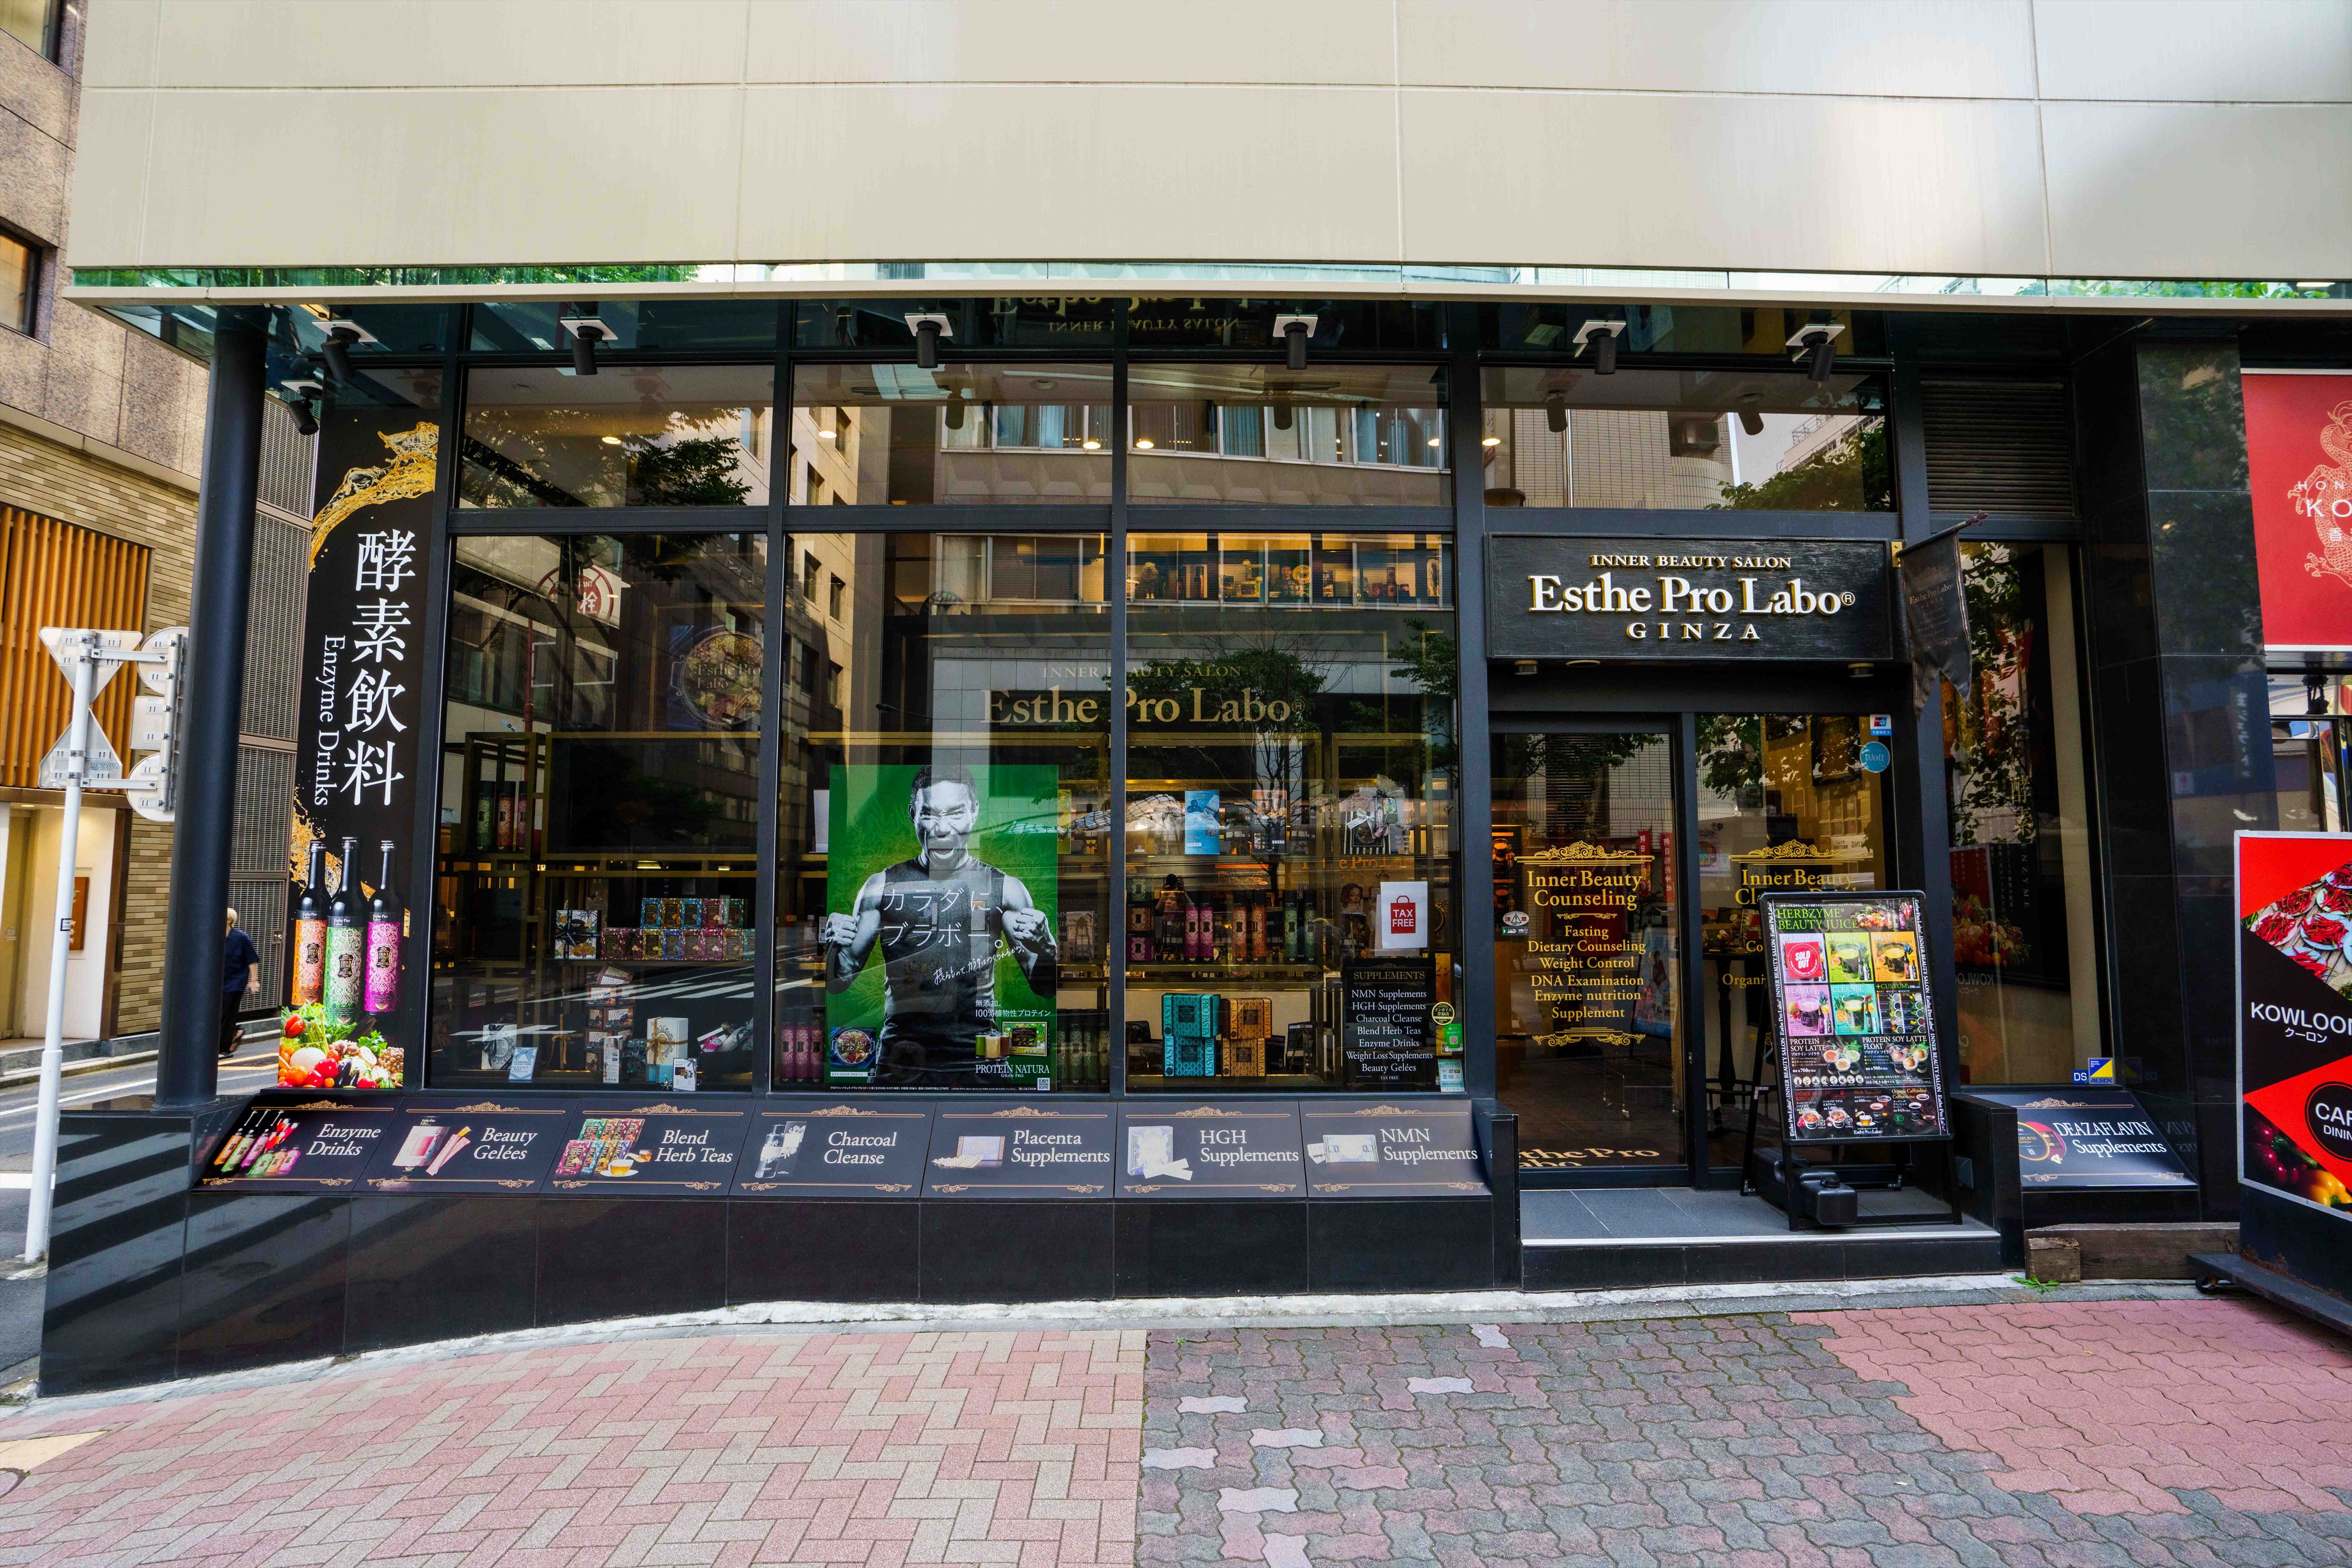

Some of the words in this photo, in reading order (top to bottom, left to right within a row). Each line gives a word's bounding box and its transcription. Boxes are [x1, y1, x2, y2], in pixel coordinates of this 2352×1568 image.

[1590, 554, 1650, 568] INNER
[1655, 556, 1728, 569] BEAUTY
[1732, 556, 1791, 569] SALON
[1528, 572, 1652, 614] Esthe
[1657, 576, 1733, 614] Pro
[1909, 594, 1927, 605] Esthe
[1626, 622, 1761, 641] GINZA
[340, 528, 416, 806] 酵素飲料
[1042, 666, 1098, 678] INNER
[1184, 666, 1241, 677] SALON
[316, 635, 345, 722] Enzyme
[979, 684, 1099, 724] Esthe
[314, 730, 340, 806] Drinks
[1527, 870, 1577, 887] Inner
[1580, 870, 1643, 891] Beauty
[1742, 869, 1792, 886] Inner
[1793, 869, 1853, 891] Beauty
[883, 887, 1004, 914] カラダに、
[1534, 889, 1638, 911] Counseling
[1393, 909, 1413, 917] TAX
[1392, 919, 1414, 927] FREE
[1778, 920, 1823, 930] BEAUTY
[1826, 919, 1859, 931] JUICE
[883, 921, 1004, 949] ブラボー。
[1564, 925, 1609, 940] Fasting
[1528, 940, 1574, 955] Dietary
[1577, 939, 1646, 954] Counseling
[1795, 950, 1811, 961] SOLD
[1539, 957, 1584, 972] Weight
[1587, 956, 1635, 968] Control
[1797, 959, 1810, 969] OUT
[1353, 971, 1425, 980] SUPPLEMENTS
[1531, 975, 1563, 987] DNA
[1567, 975, 1644, 986] Examination
[1351, 989, 1376, 998] NMN
[1378, 989, 1427, 1000] Supplements
[1535, 990, 1582, 1004] Enzyme
[1586, 989, 1641, 1000] nutrition
[1352, 1001, 1375, 1010] HGH
[1378, 1001, 1426, 1012] Supplements
[1552, 1006, 1625, 1022] Supplement
[1356, 1014, 1390, 1022] Charcoal
[1392, 1014, 1422, 1022] Cleanse
[2251, 1001, 2352, 1036] KOWLOO
[1357, 1026, 1380, 1035] Blend
[1382, 1026, 1403, 1035] Herb
[2285, 1027, 2327, 1043] クーロン
[1359, 1039, 1390, 1049] Enzyme
[1392, 1039, 1420, 1047] Drinks
[1346, 1051, 1371, 1062] Weight
[1389, 1051, 1433, 1062] Supplements
[975, 1065, 1013, 1074] PROTEIN
[1015, 1065, 1050, 1074] NATURA
[1362, 1063, 1388, 1074] Beauty
[1390, 1063, 1416, 1071] Gelées
[2073, 1072, 2087, 1081] DS
[316, 1124, 381, 1142] Enzyme
[480, 1127, 537, 1146] Beauty
[1013, 1129, 1082, 1145] Placenta
[1200, 1129, 1247, 1145] HGH
[1379, 1128, 1430, 1144] NMN
[2053, 1122, 2154, 1136] DEAZAFLAVIN
[661, 1130, 708, 1145] Blend
[828, 1131, 897, 1147] Charcoal
[306, 1140, 363, 1156] Drinks
[473, 1145, 527, 1160] Gelées
[655, 1148, 696, 1163] Herb
[701, 1148, 733, 1163] Teas
[1584, 1148, 1661, 1158] Pro
[2072, 1138, 2167, 1158] Supplements
[824, 1149, 885, 1165] Cleanse
[1011, 1147, 1110, 1167] Supplements
[1200, 1147, 1299, 1167] Supplements
[1383, 1148, 1478, 1168] Supplements
